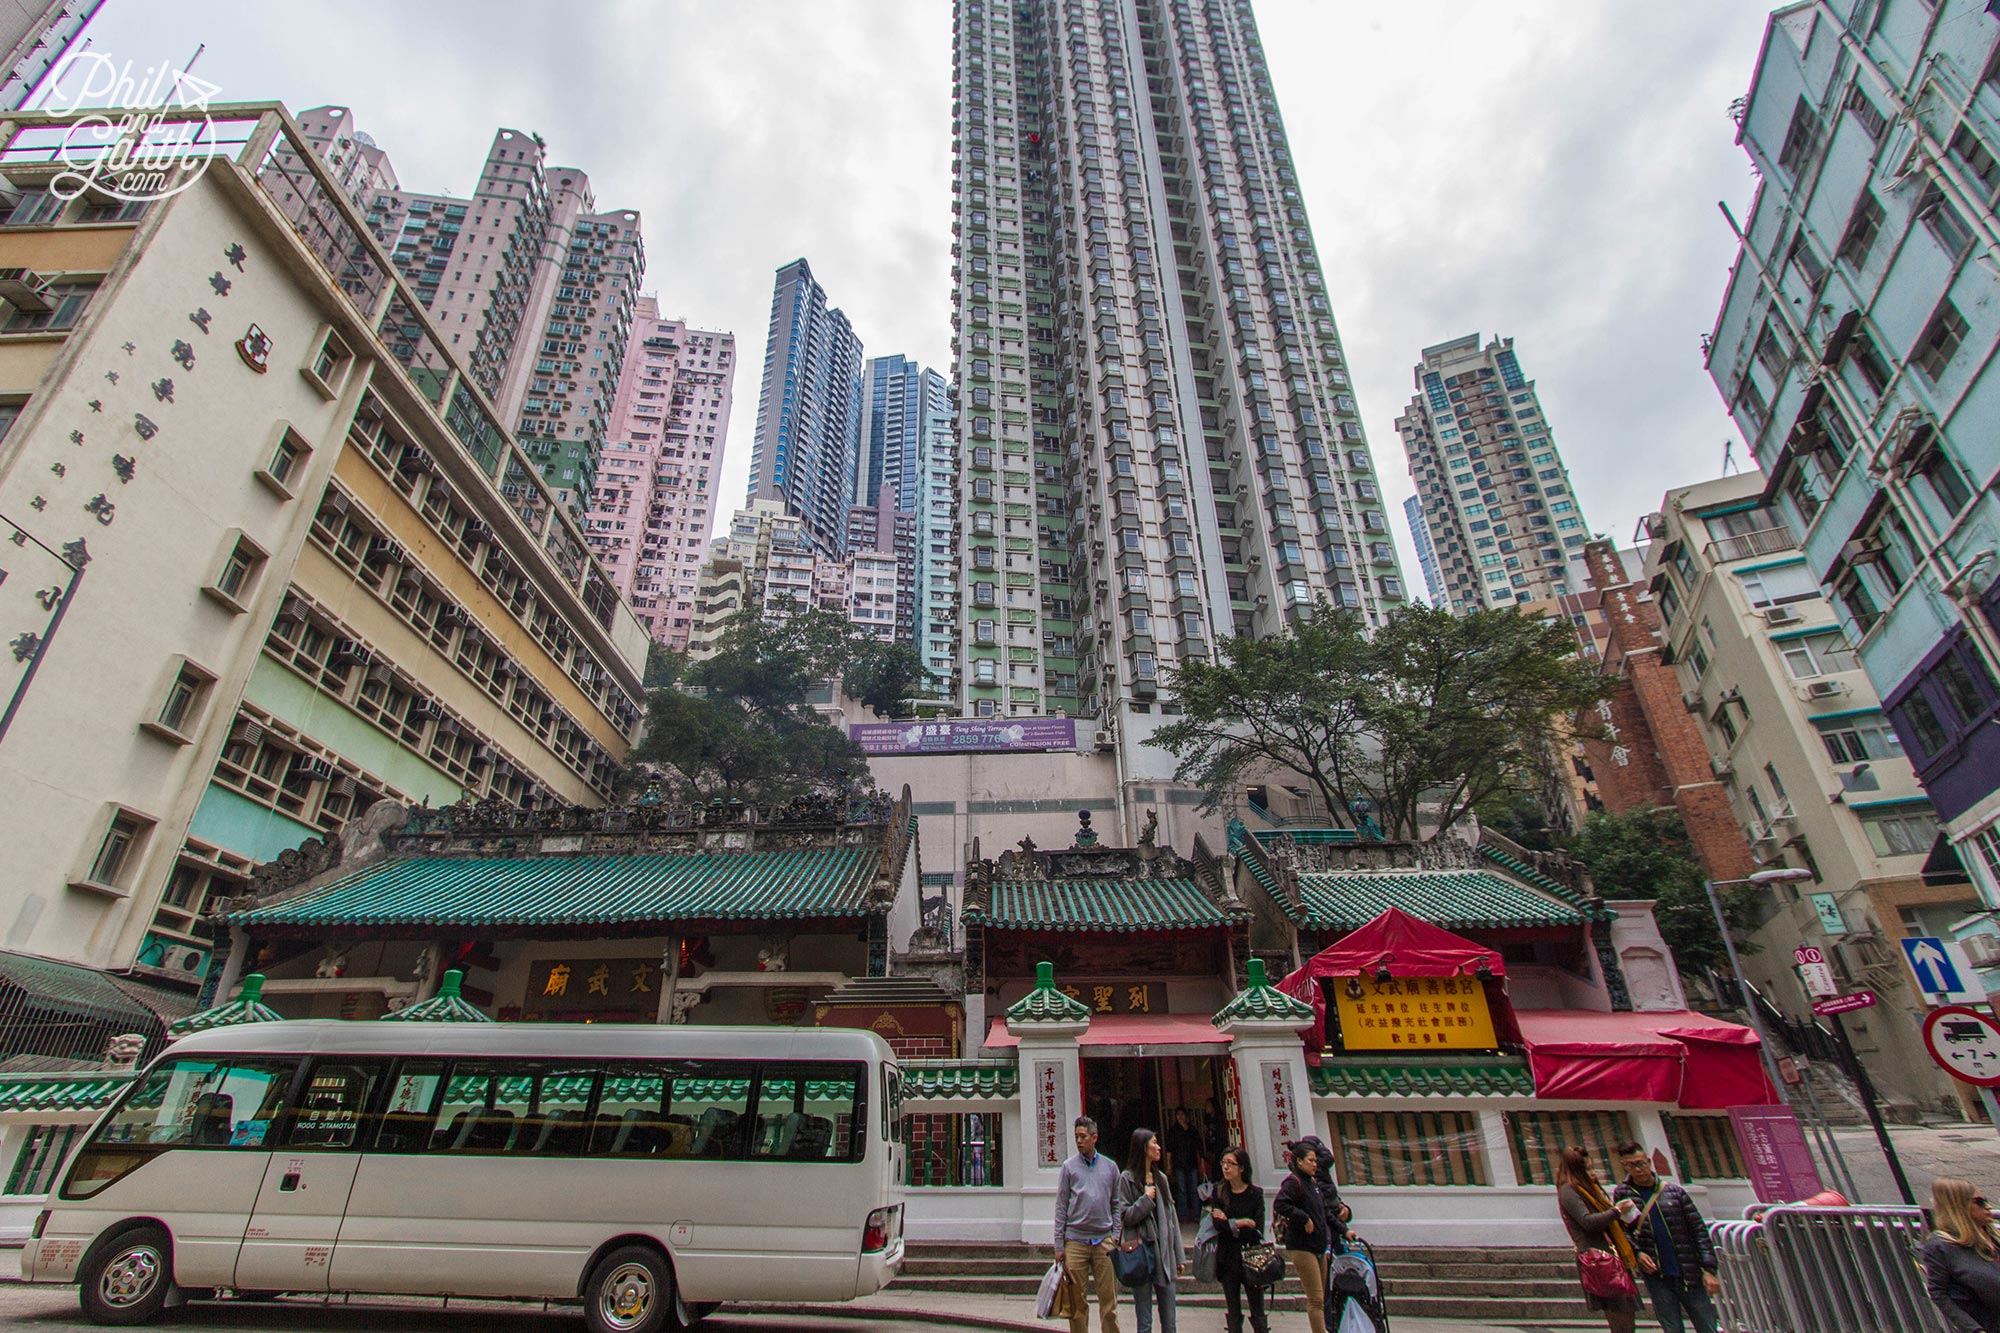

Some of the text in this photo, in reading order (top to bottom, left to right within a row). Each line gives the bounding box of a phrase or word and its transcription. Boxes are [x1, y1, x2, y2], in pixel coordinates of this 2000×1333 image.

[1595, 699, 1632, 767] 青年會
[952, 735, 979, 745] 2859
[1356, 1001, 1472, 1014] 延生牌位 往生牌位
[1391, 1033, 1448, 1044] 歡迎參觀
[1967, 1049, 1977, 1060] 7
